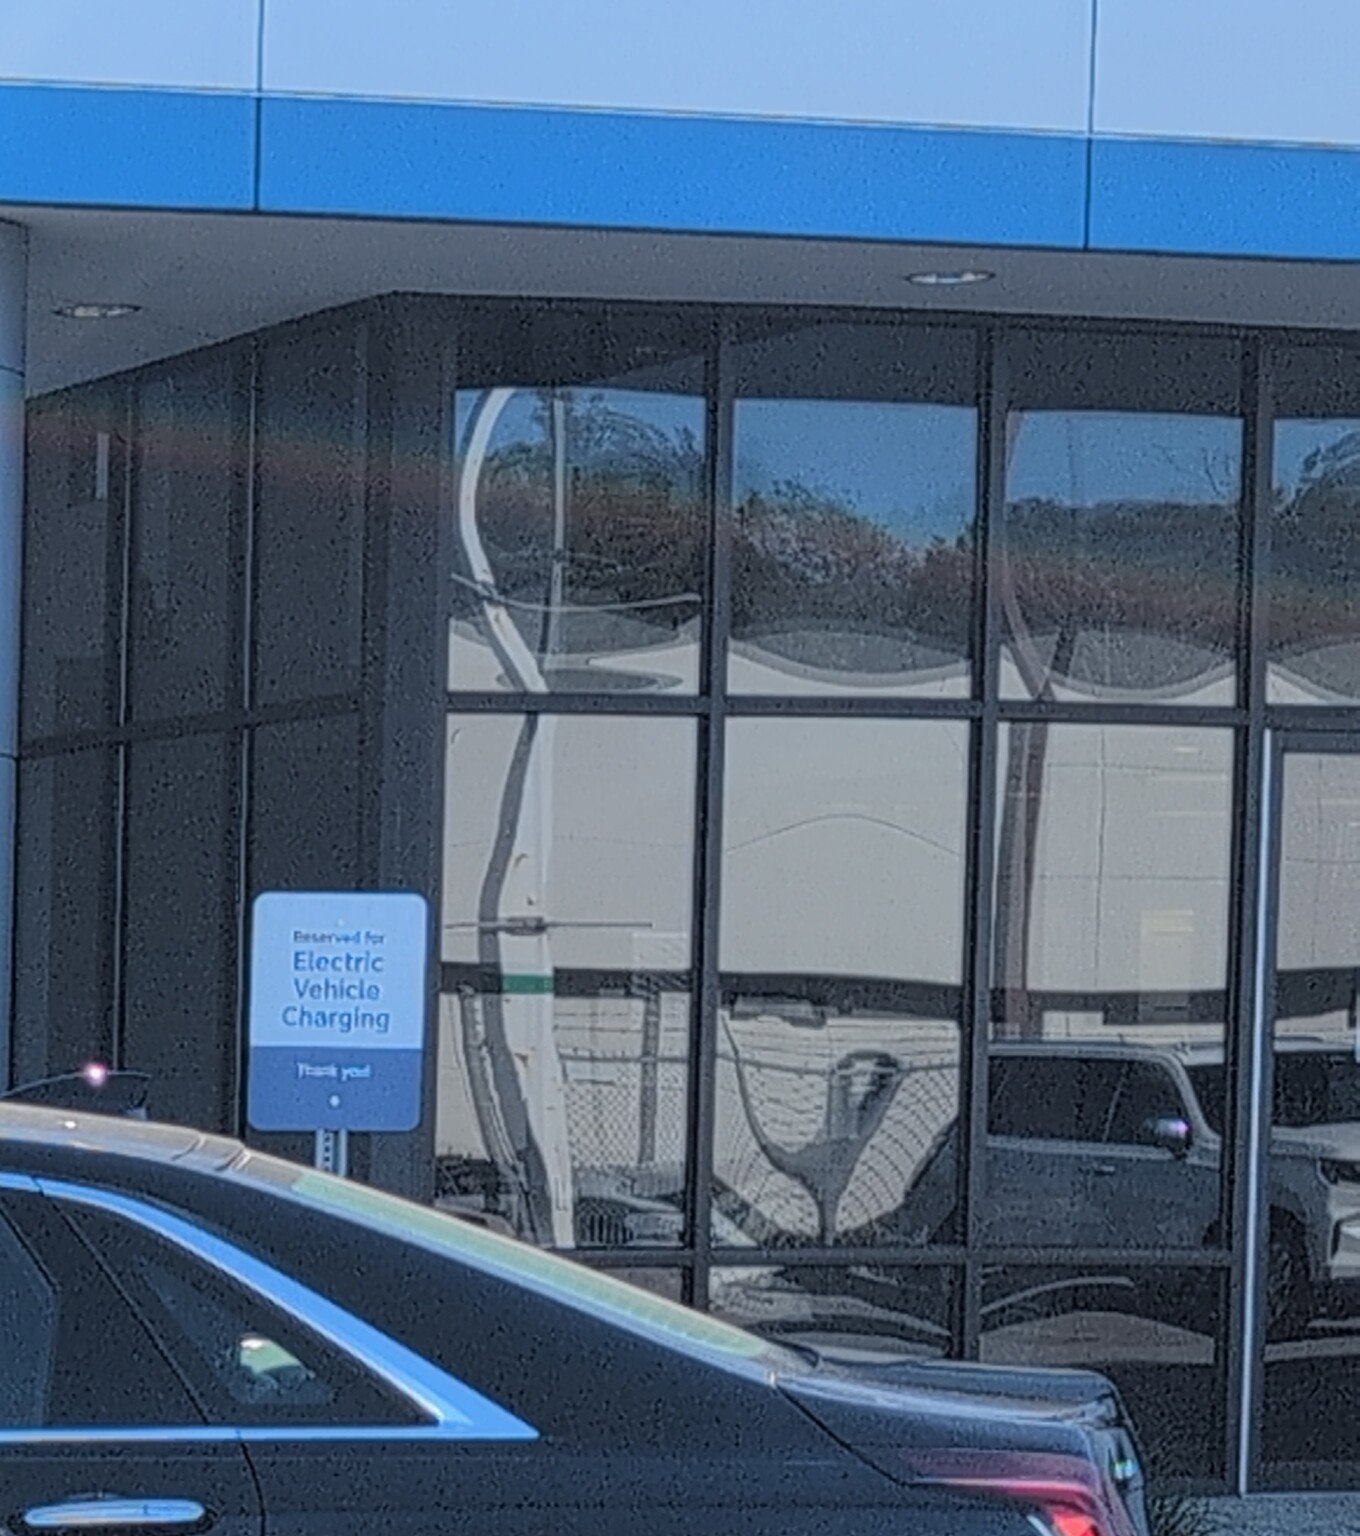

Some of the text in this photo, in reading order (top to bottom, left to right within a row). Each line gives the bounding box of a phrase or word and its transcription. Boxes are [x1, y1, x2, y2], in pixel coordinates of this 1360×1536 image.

[293, 931, 384, 944] Reserved for
[293, 951, 384, 972] Electric
[294, 979, 380, 1000] Vehicle
[282, 1006, 390, 1033] Charging
[297, 1063, 337, 1078] Thank
